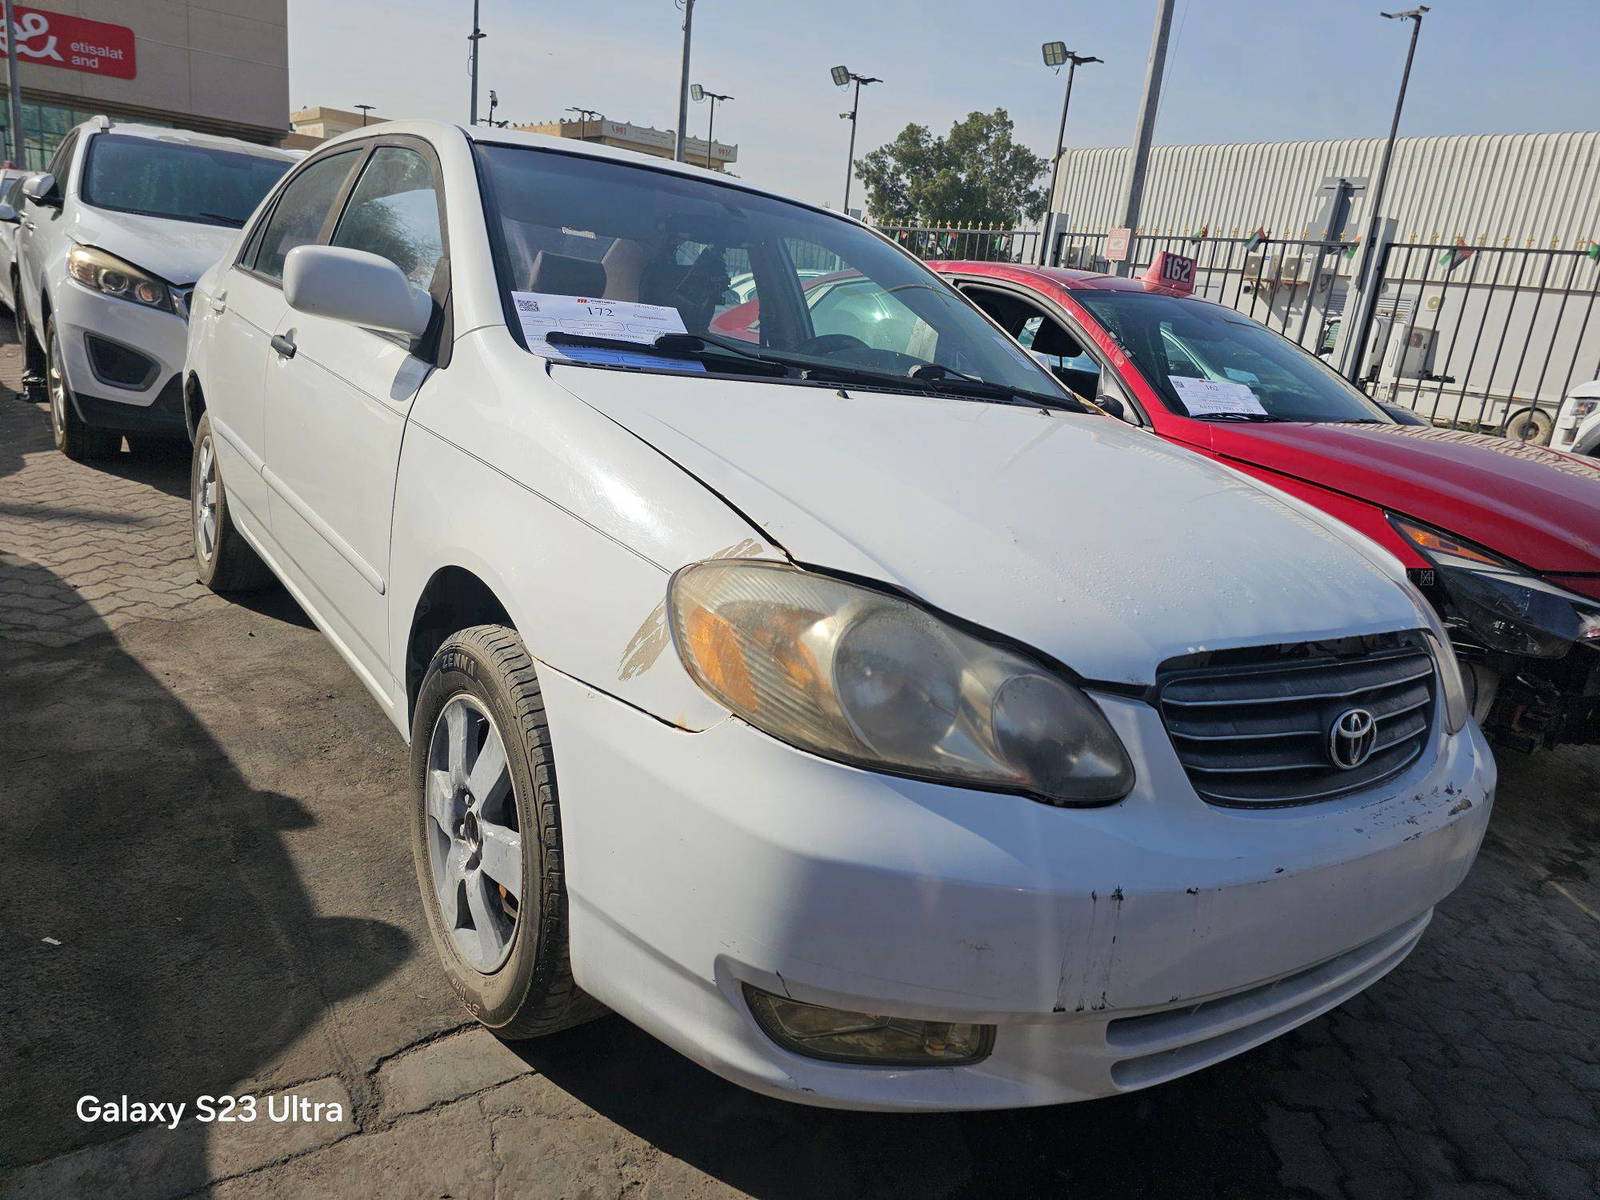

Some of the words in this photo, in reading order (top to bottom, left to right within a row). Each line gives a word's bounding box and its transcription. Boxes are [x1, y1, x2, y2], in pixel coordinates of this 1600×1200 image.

[70, 40, 124, 60] etisalat
[71, 55, 99, 69] and
[1166, 255, 1192, 283] 162
[587, 306, 614, 316] 172
